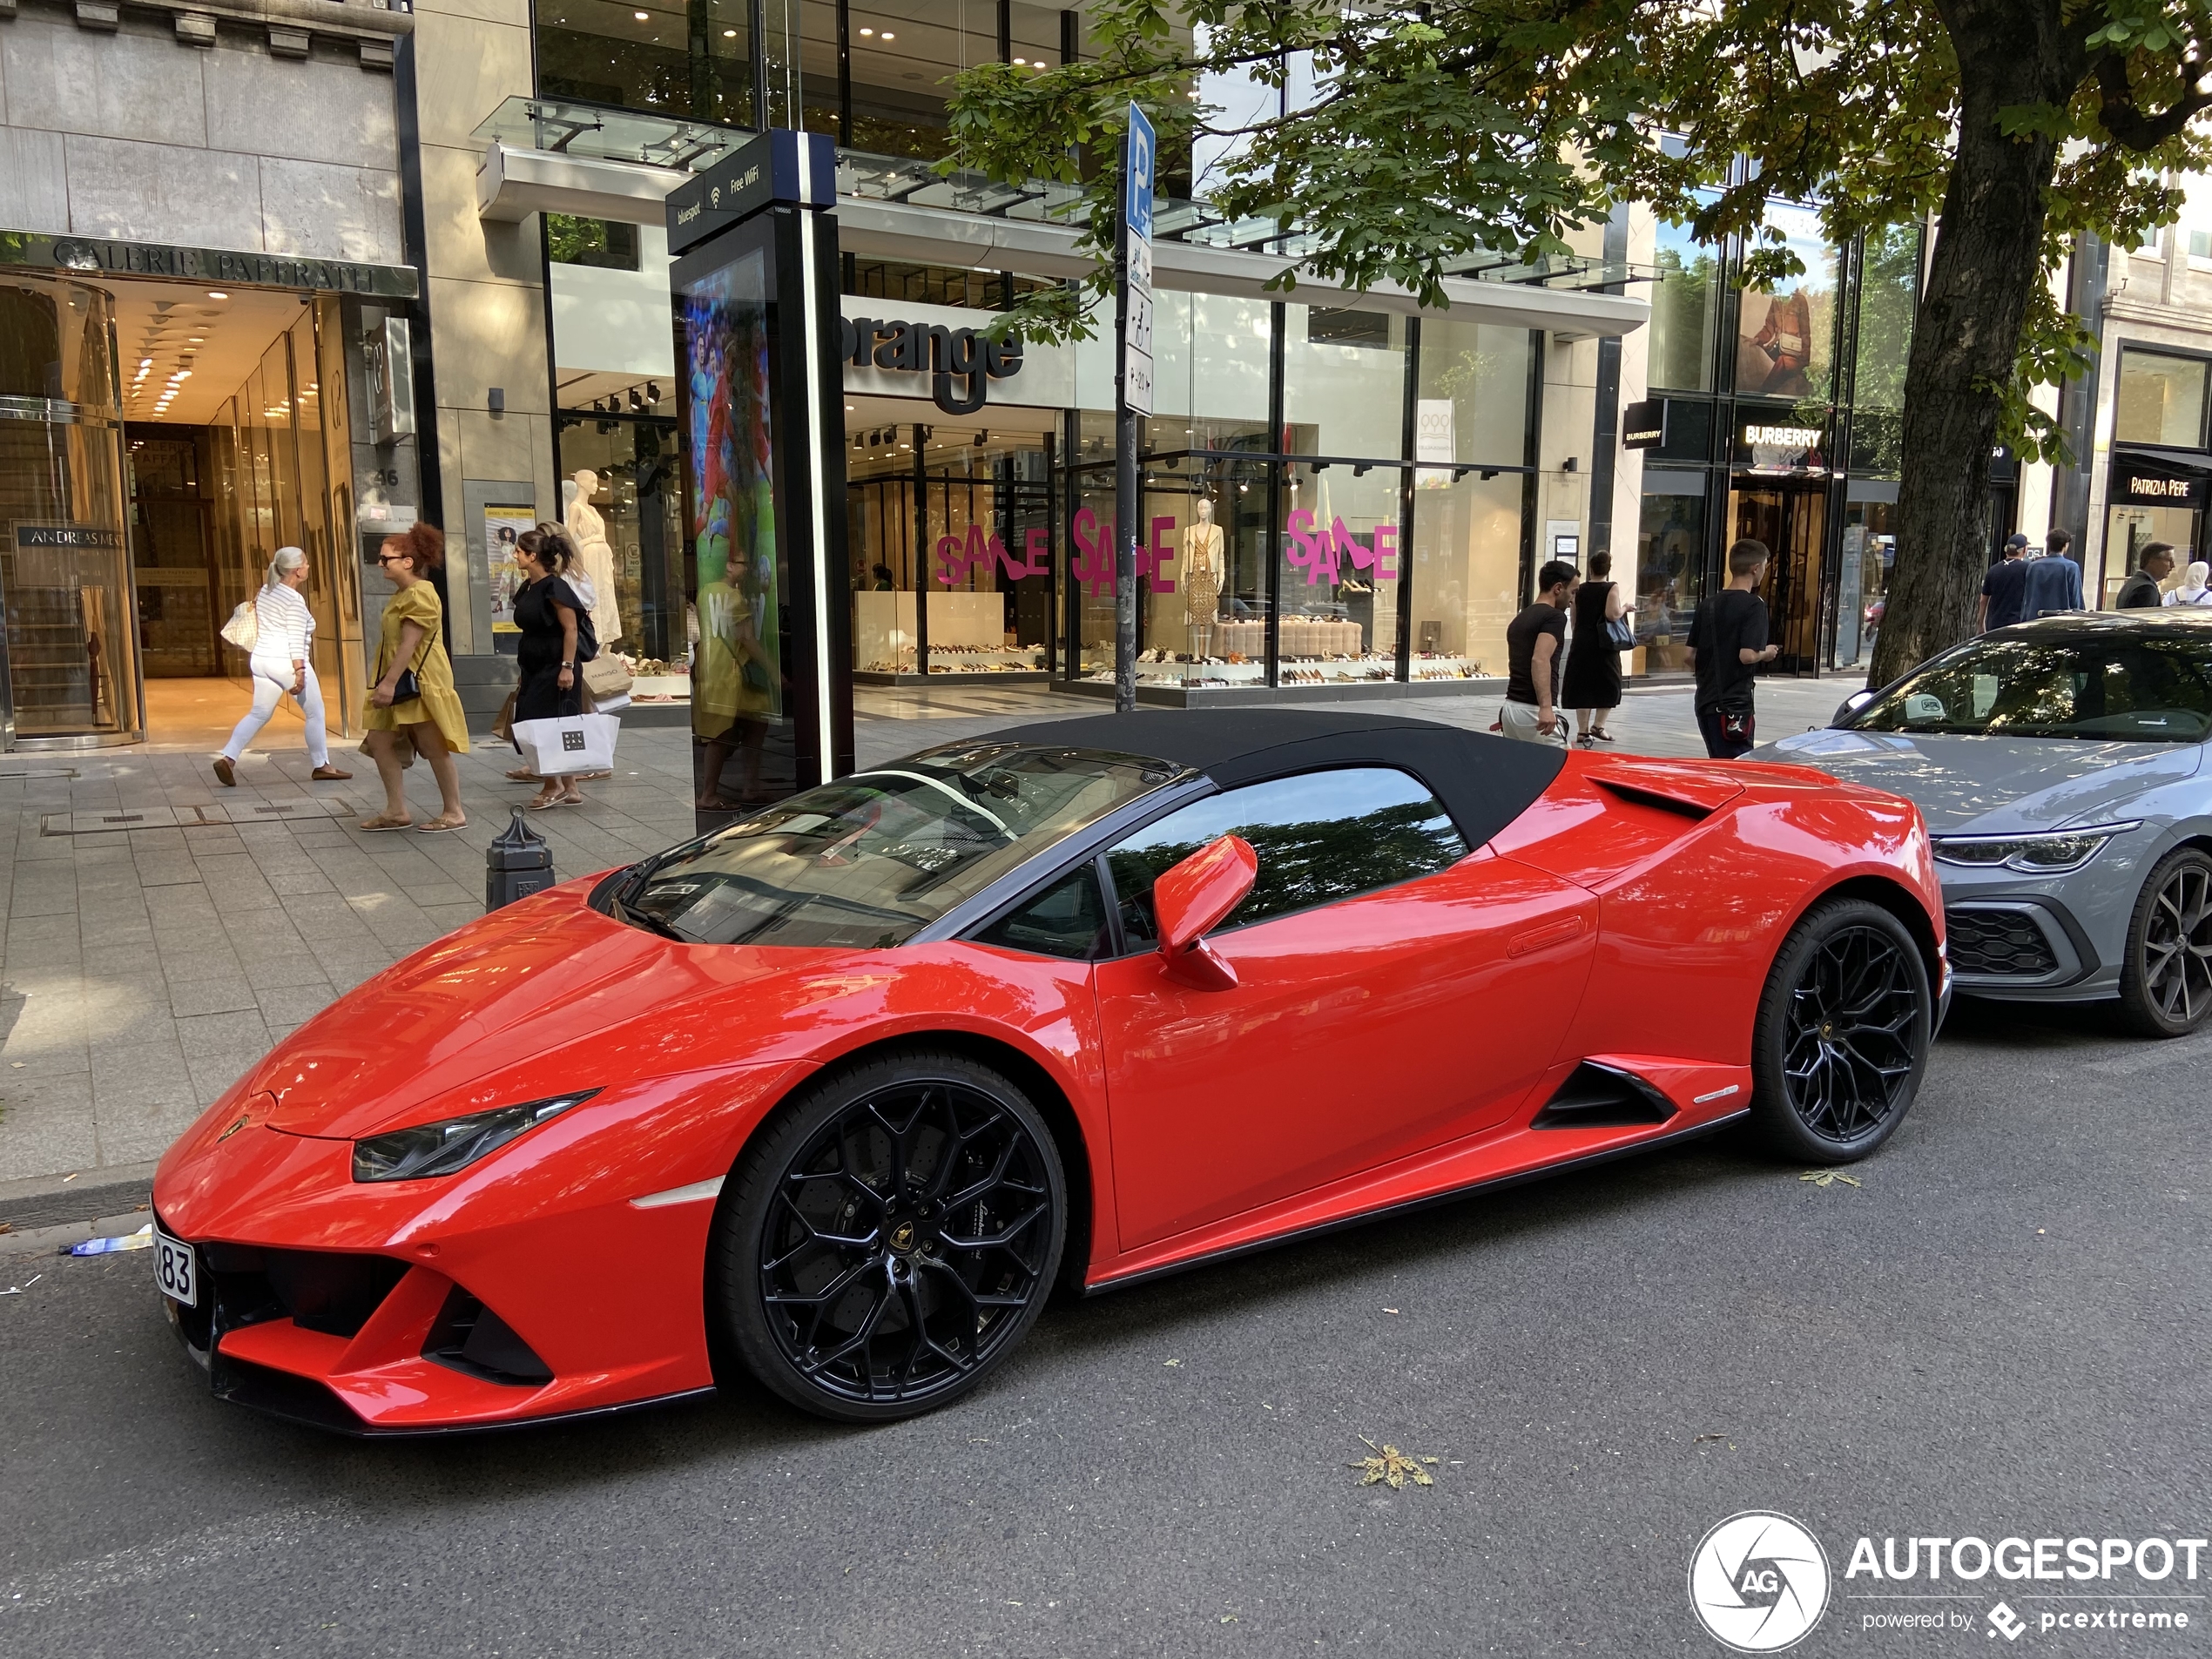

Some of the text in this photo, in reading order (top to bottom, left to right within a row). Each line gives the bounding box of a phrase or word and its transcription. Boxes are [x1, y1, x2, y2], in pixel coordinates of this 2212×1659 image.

[731, 164, 759, 194] Free WiFi
[678, 200, 701, 226] bluespot
[52, 241, 375, 293] GALERIE PAFFRATH
[1626, 429, 1662, 441] BURBERRY
[1744, 425, 1823, 448] BURBERRY
[374, 469, 399, 486] 46
[2131, 476, 2189, 497] PATRIZIA PEPE
[31, 530, 98, 545] ANDREAS
